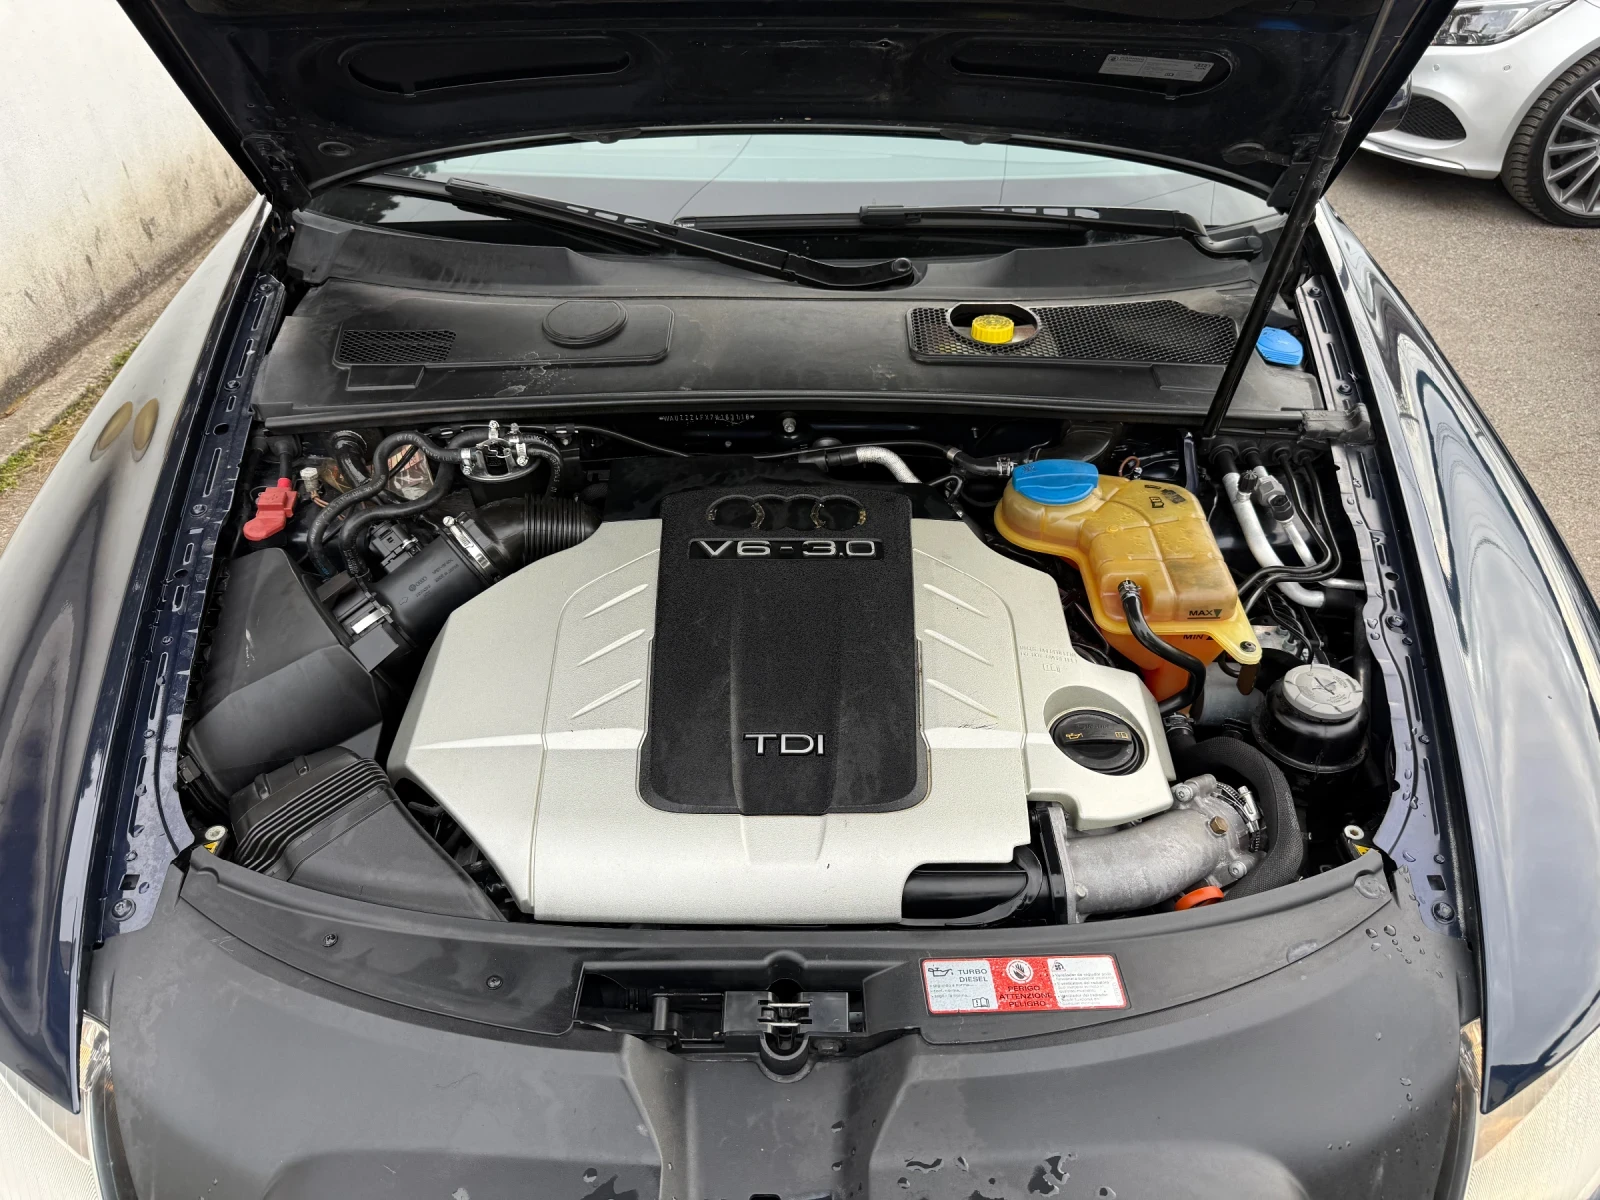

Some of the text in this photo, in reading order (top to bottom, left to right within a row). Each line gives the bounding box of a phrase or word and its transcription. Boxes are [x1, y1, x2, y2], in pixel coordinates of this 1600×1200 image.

[744, 733, 824, 754] TDI
[999, 992, 1053, 1000] ATTENZIONE
[1008, 1000, 1047, 1008] PELIGRO
